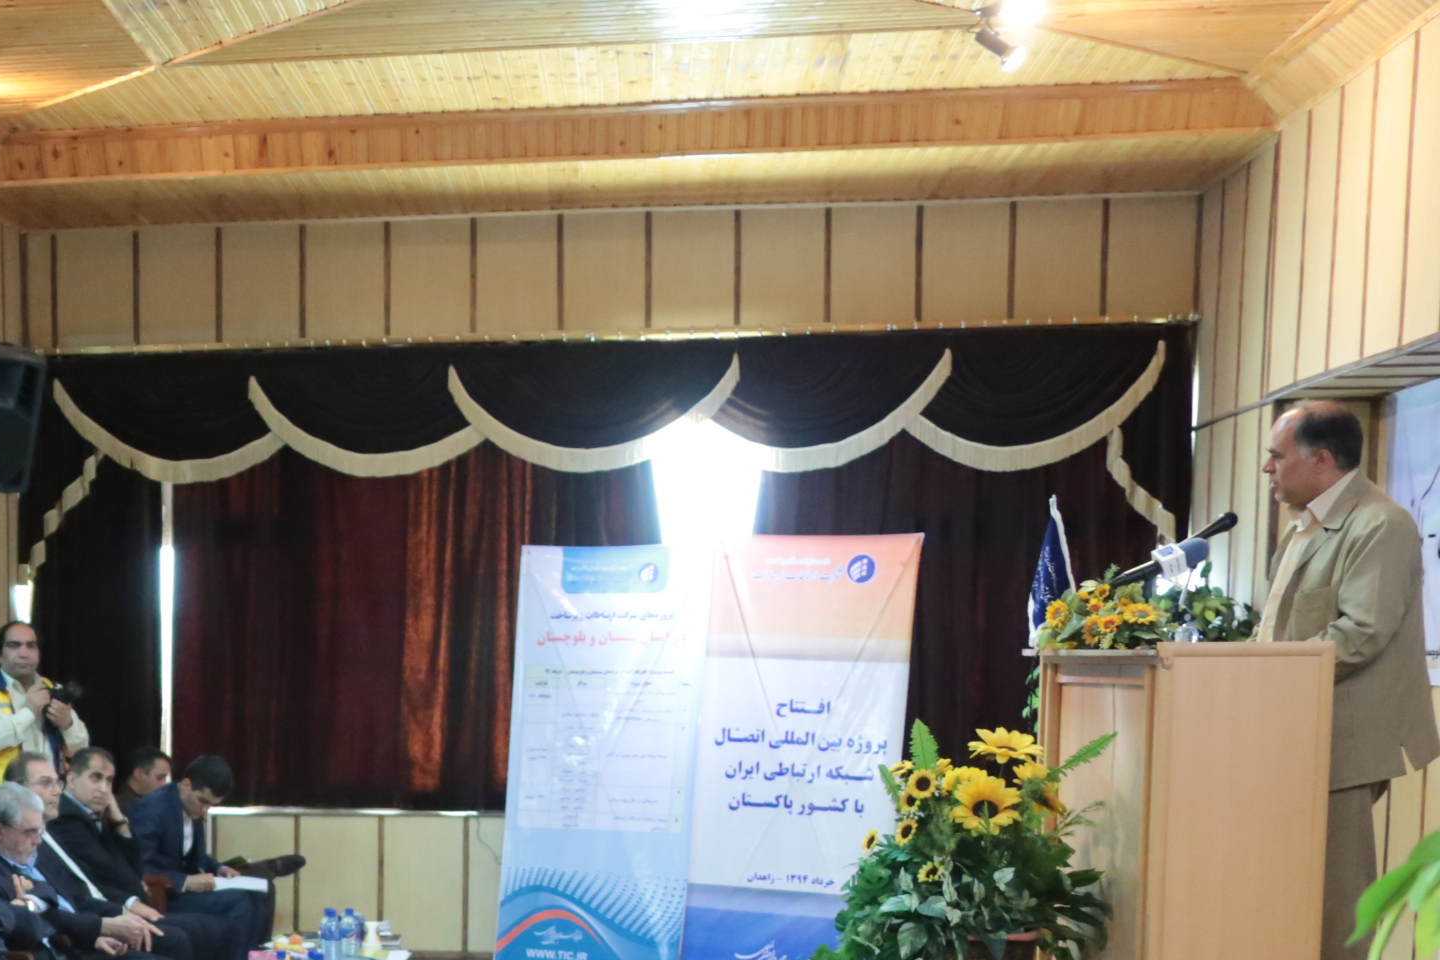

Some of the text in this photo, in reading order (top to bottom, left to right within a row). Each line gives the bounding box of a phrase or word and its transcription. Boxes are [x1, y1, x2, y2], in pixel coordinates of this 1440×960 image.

[775, 698, 831, 717] افتتاح
[768, 730, 816, 749] المللی
[817, 737, 842, 751] بین
[846, 735, 888, 755] پروژه
[725, 761, 874, 784] شبکه ارتباطی ایران
[728, 792, 865, 818] با کشور پاکستان
